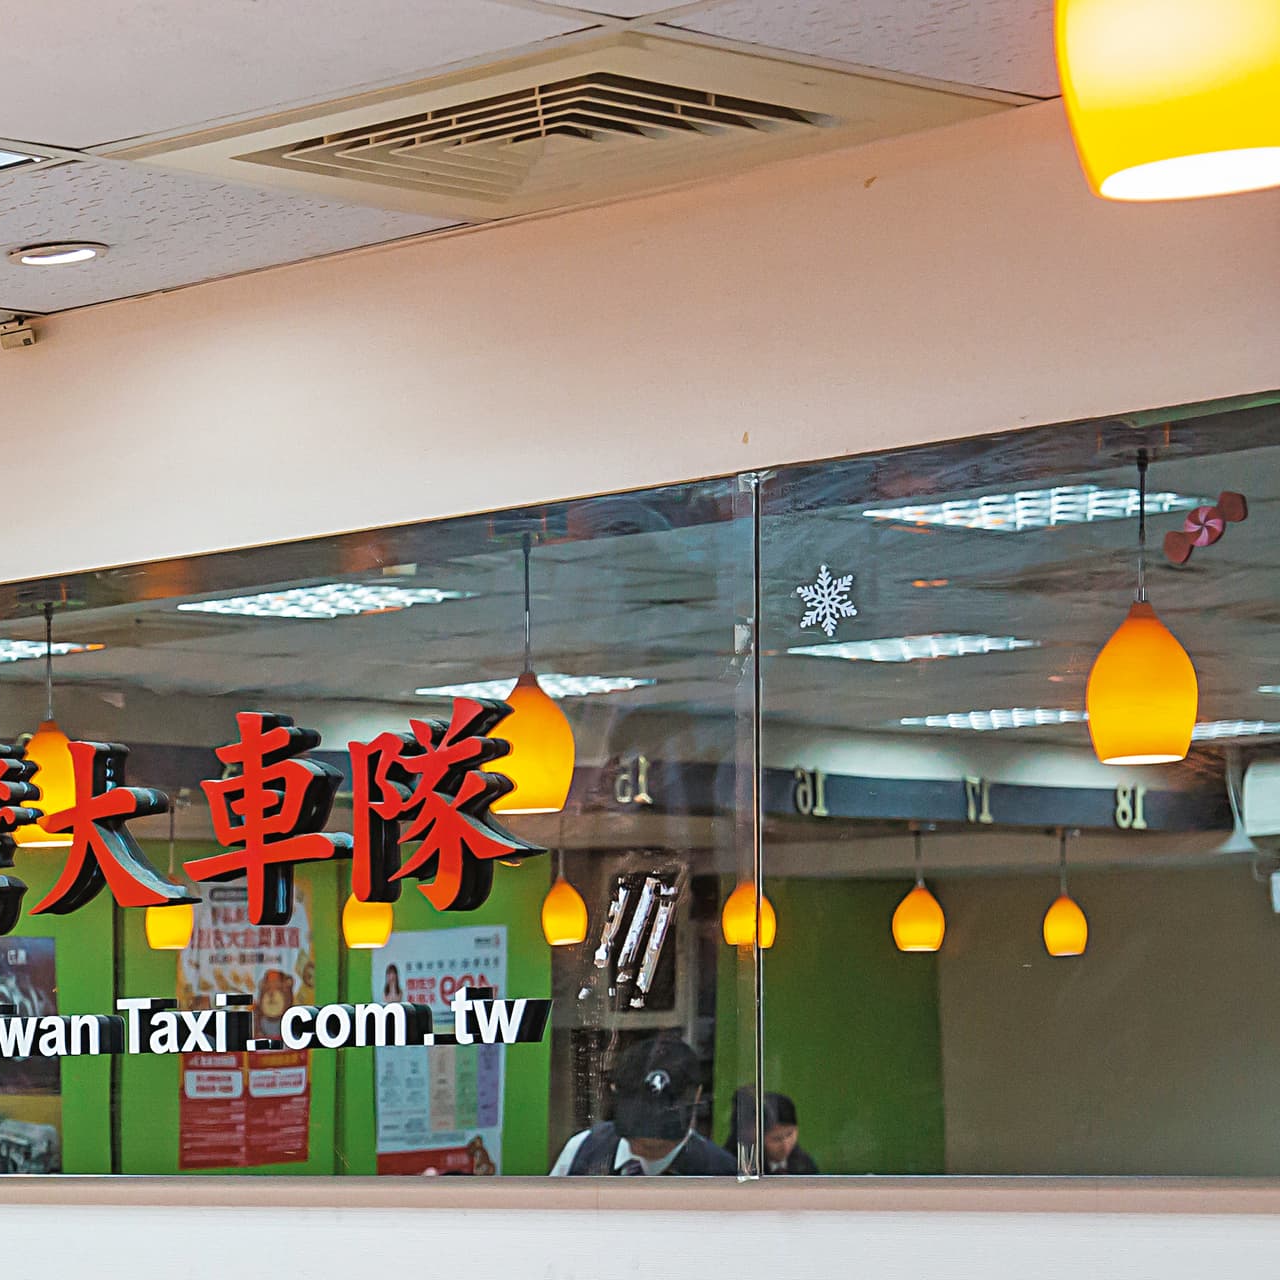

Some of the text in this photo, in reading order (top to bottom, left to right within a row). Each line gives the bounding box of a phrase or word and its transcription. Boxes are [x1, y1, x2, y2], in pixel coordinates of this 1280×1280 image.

[116, 994, 228, 1055] Taxi
[280, 1002, 406, 1050] com
[451, 987, 528, 1045] tw
